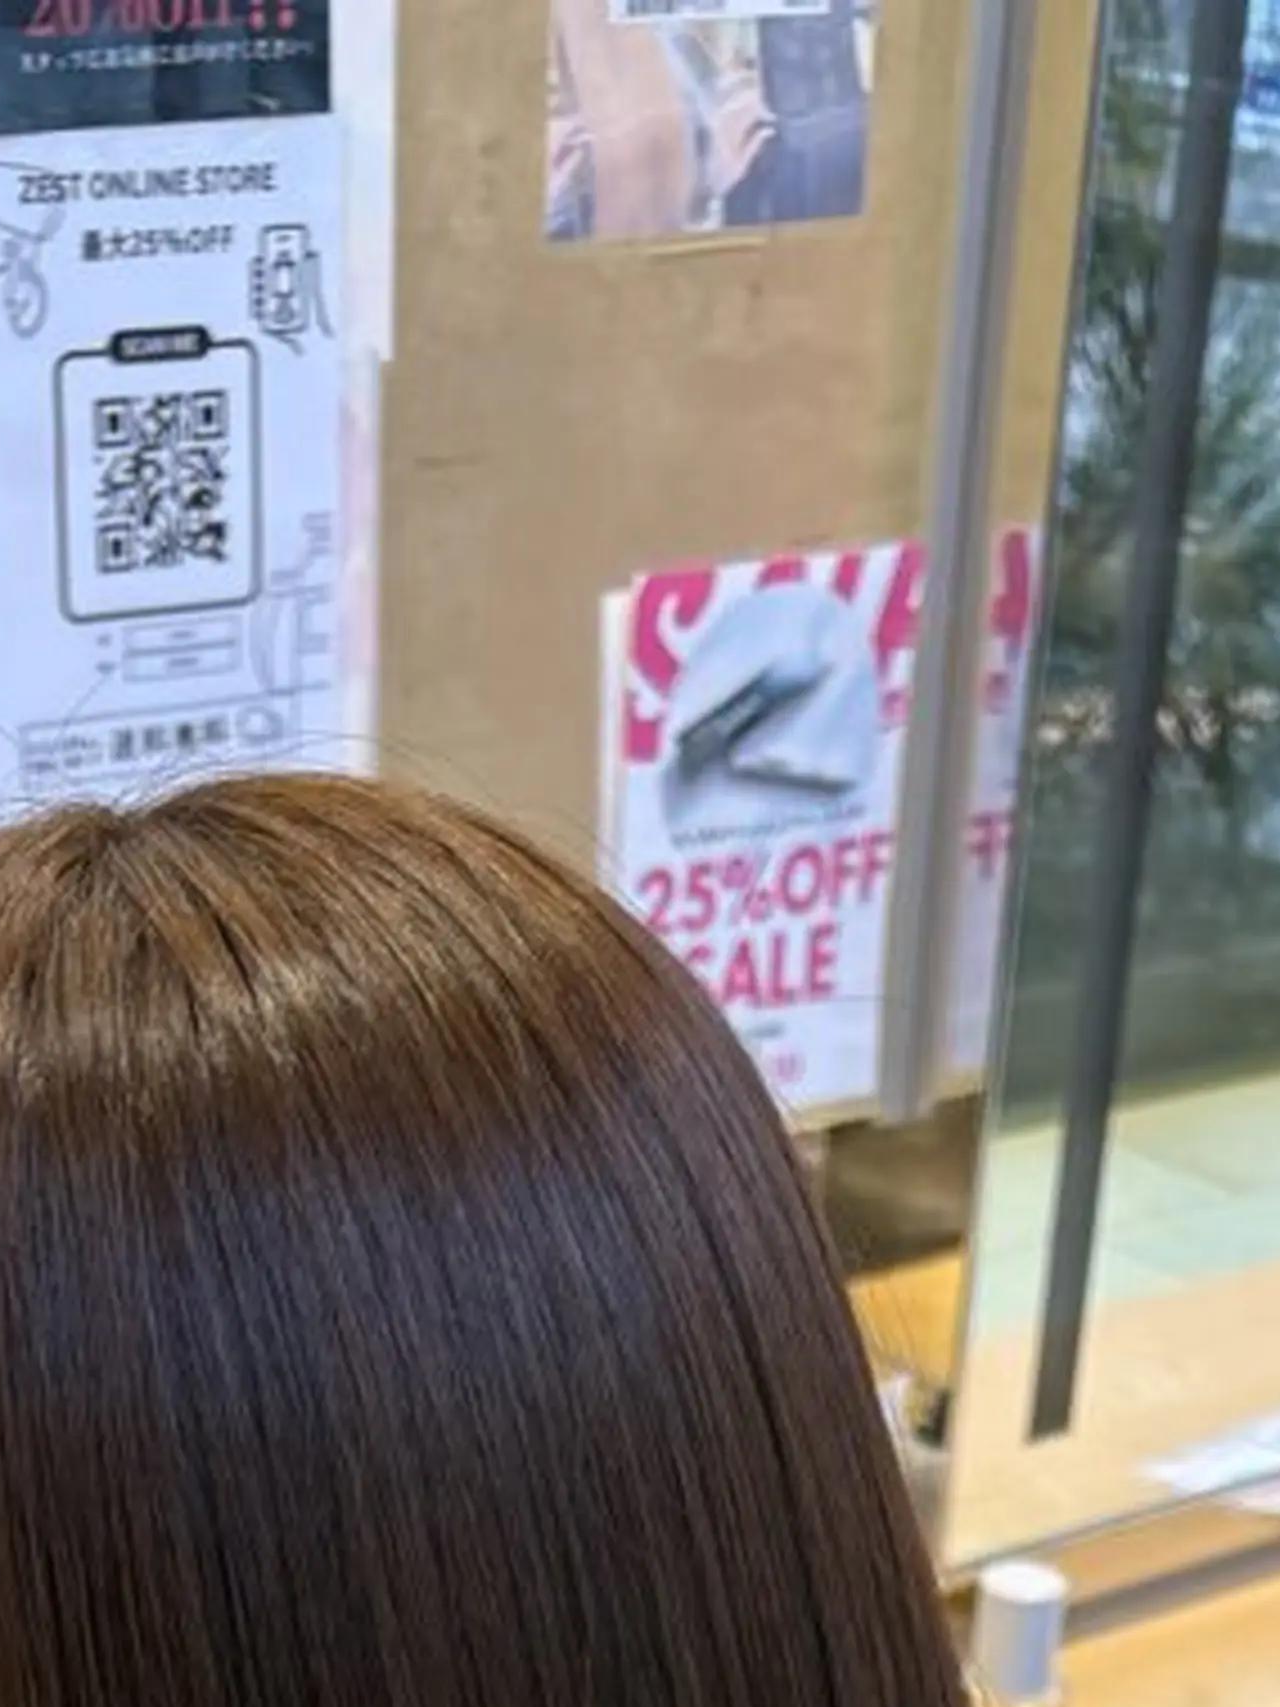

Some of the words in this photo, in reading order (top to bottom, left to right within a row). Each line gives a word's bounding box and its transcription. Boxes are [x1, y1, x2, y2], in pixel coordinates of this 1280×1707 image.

[17, 172, 82, 205] ZEST
[88, 167, 190, 200] ONLINE
[195, 161, 278, 195] STORE
[639, 830, 894, 936] 25%OFF
